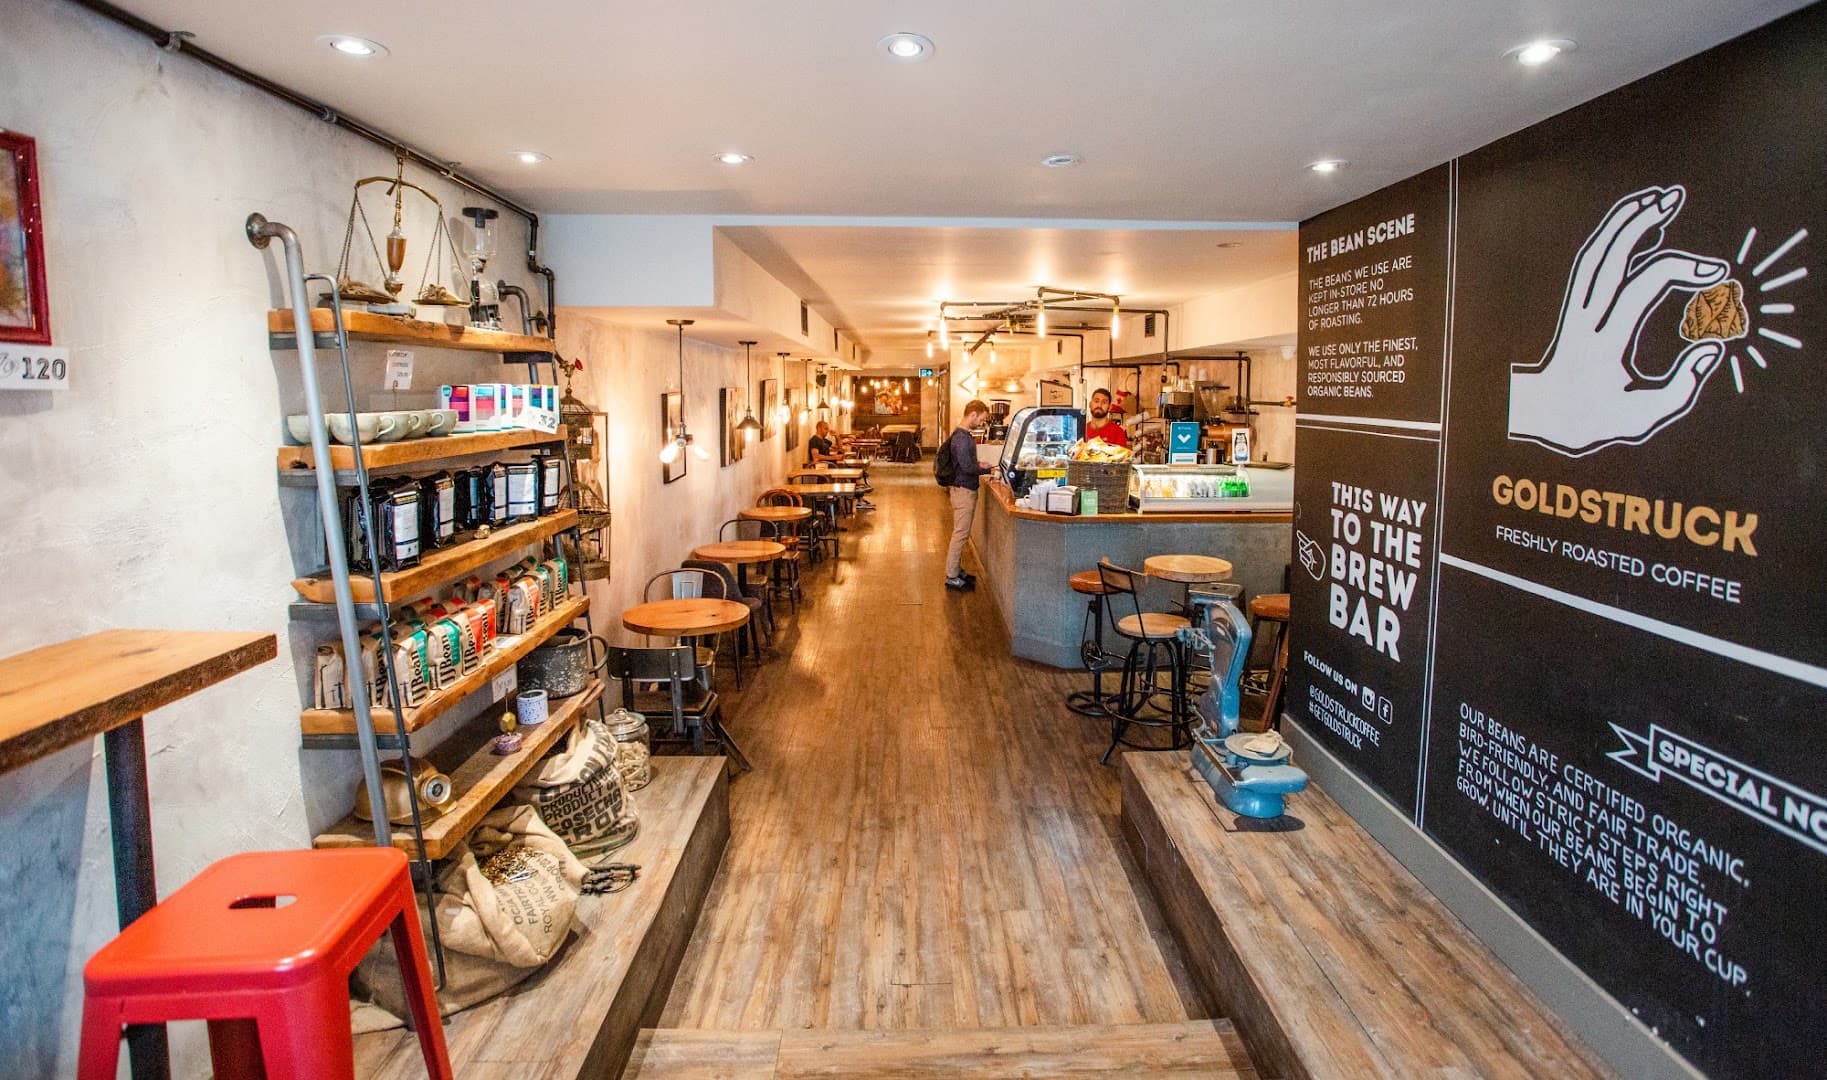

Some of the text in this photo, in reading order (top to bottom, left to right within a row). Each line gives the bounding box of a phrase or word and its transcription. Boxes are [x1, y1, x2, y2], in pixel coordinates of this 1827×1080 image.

[1307, 213, 1415, 263] THE BEAN SCENE
[1309, 255, 1412, 291] THE BEANS WE USE ARE
[1309, 278, 1384, 304] KEPT IN-STORE NO
[1309, 288, 1413, 317] LONGER THAN 72 HOURS
[1309, 313, 1362, 331] OF ROASTING.
[22, 356, 66, 380] 120
[1309, 346, 1320, 357] WE
[1322, 345, 1336, 356] USE
[1339, 343, 1360, 355] ONLY
[1363, 340, 1380, 353] THE
[1309, 354, 1405, 370] MOST FLAVORFUL, AND
[1308, 370, 1405, 384] RESPONSIBLY SOURCED
[1308, 386, 1374, 398] ORGANIC BEANS.
[1331, 481, 1427, 528] THIS WAY
[1492, 474, 1758, 557] GOLDSTRUCK
[1330, 508, 1422, 569] TO THE
[1331, 543, 1417, 611] BREW
[1496, 525, 1742, 604] FRESHLY ROASTED COFFEE
[1329, 582, 1400, 663] BAR
[1304, 650, 1358, 697] FOLLOW US ON
[1308, 700, 1362, 751] #GETGOLDSTRUCK
[1309, 684, 1380, 748] @GOLDSTRUCKCOFFEE
[1459, 702, 1750, 888] OUR BEANS ARE CERTIFIED ORGANIC,
[1658, 738, 1778, 817] SPECIAL
[1459, 723, 1705, 888] BIRD-FRIENDLY, AND FAIR TRADE.
[1459, 740, 1727, 925] WE FOLLOW STRICT STEPS RIGHT
[1459, 759, 1716, 944] FROM WHEN OUR BEANS BEGIN TO
[1493, 803, 1531, 842] UNTIL
[1536, 830, 1580, 873] THEY
[1587, 870, 1619, 904] ARE
[1626, 894, 1643, 920] IN
[1651, 912, 1700, 961] YOUR
